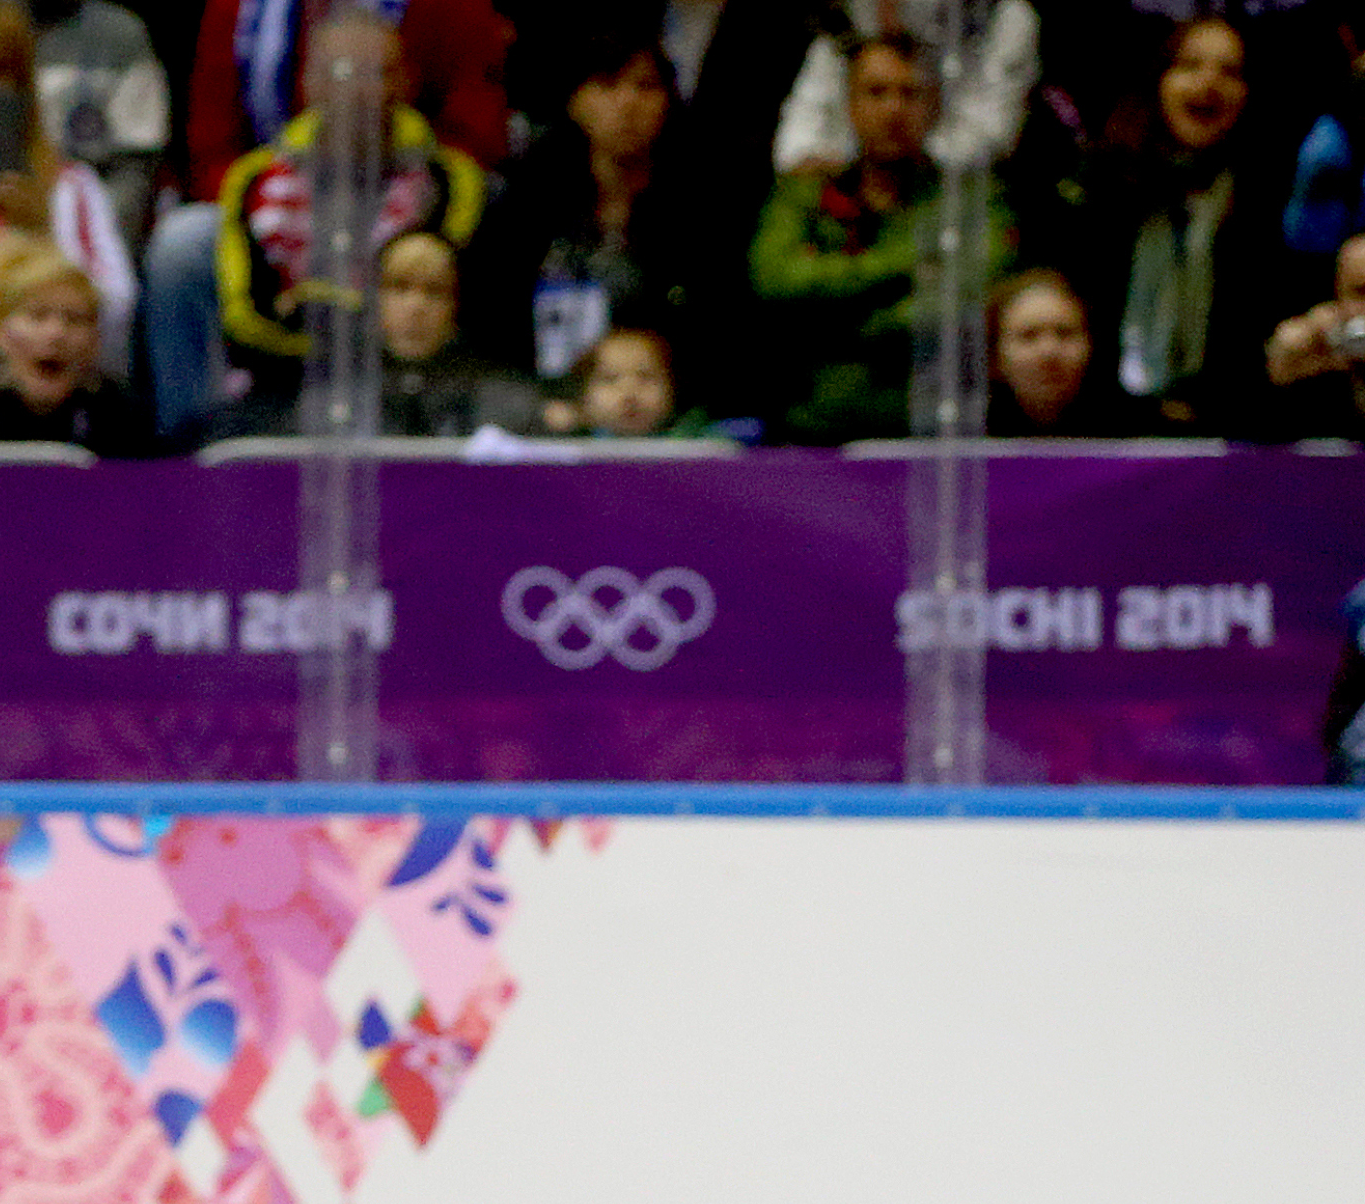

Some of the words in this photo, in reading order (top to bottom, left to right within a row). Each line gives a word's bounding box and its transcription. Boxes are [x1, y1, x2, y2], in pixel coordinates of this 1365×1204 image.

[47, 588, 227, 654] СОЧИ
[894, 584, 1105, 653] SOCHI
[1116, 582, 1272, 652] 2014
